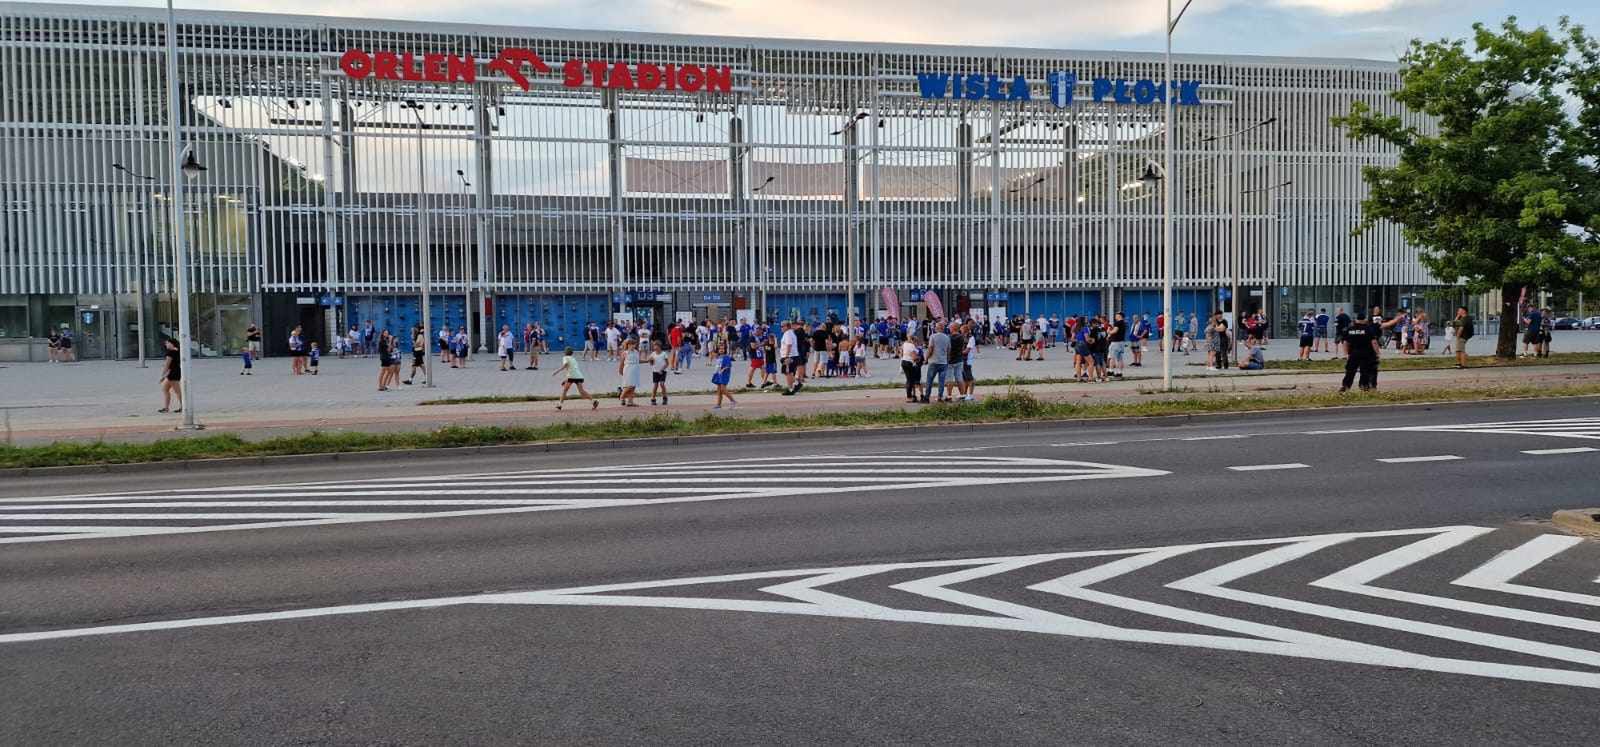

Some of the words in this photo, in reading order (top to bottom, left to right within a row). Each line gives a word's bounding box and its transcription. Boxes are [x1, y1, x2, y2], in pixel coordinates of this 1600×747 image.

[339, 48, 476, 83] ORLEN
[562, 59, 732, 93] STADION
[917, 72, 1031, 101] WISŁA
[1093, 77, 1201, 105] PŁOCK
